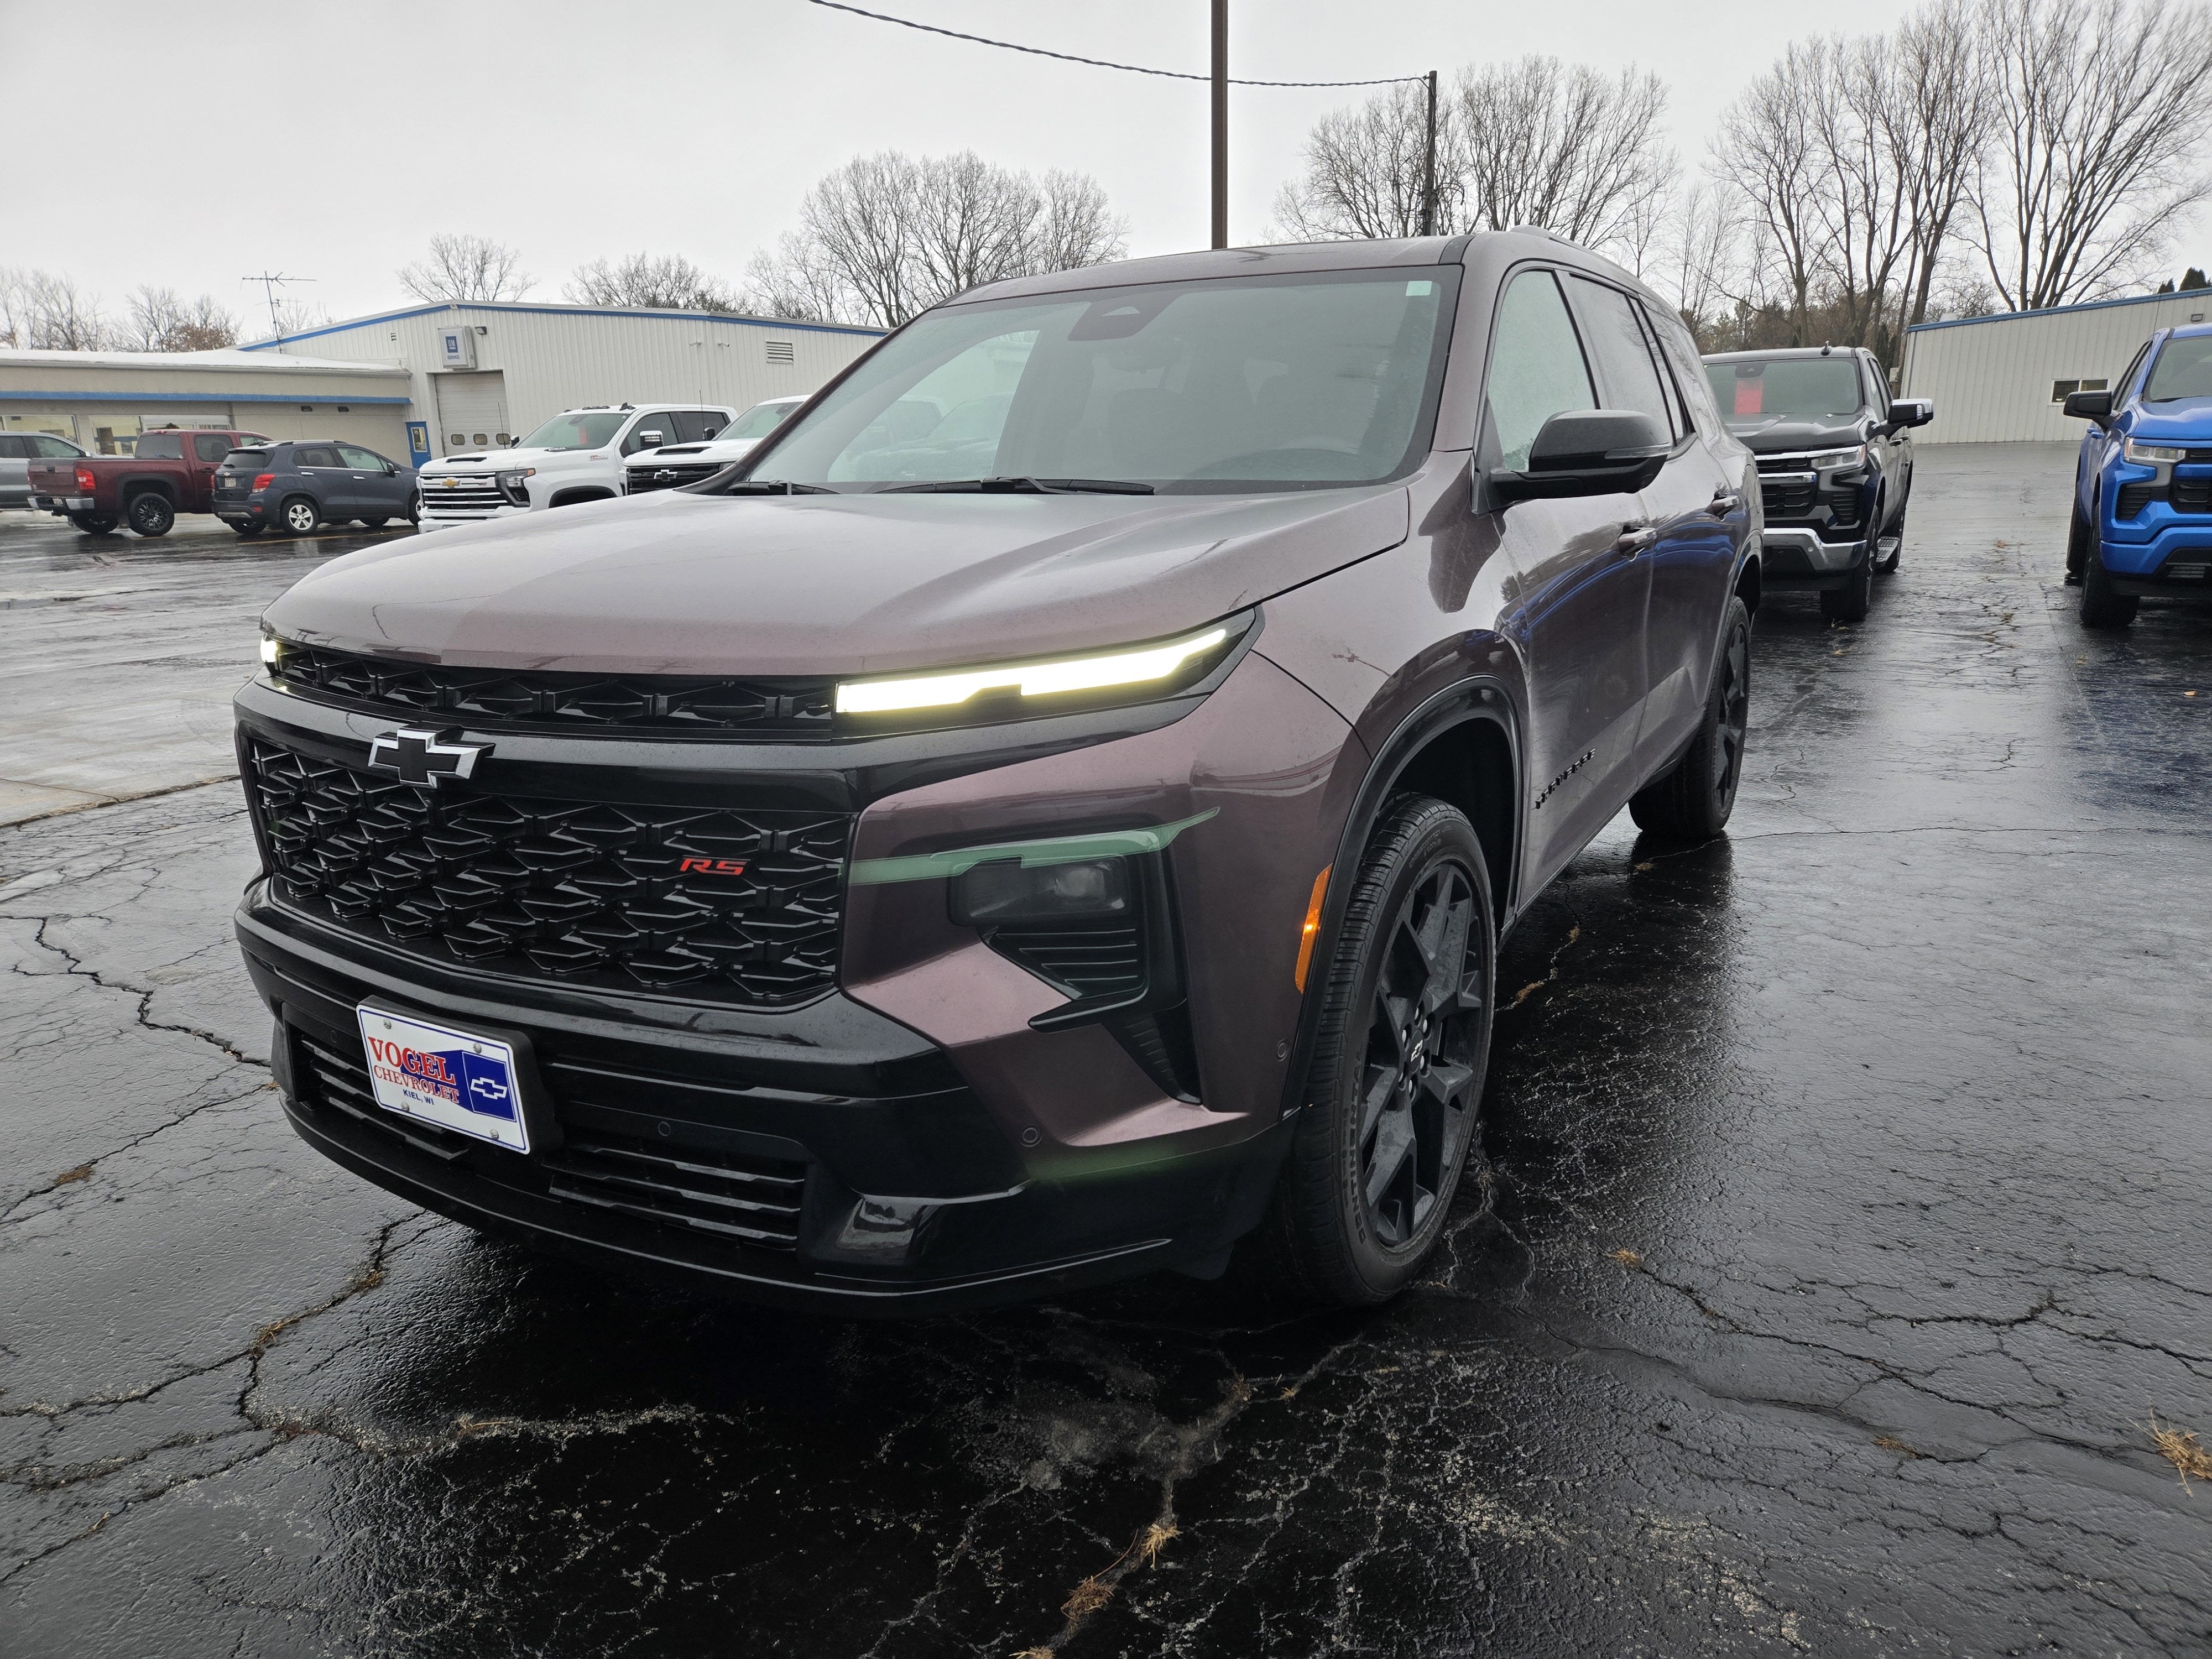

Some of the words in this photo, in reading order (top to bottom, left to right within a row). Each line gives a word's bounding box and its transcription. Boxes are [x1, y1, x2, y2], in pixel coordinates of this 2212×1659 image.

[448, 339, 456, 347] GM
[679, 858, 747, 875] RS
[368, 1036, 456, 1085] VOGEL
[374, 1065, 460, 1104] CHEVROLET
[403, 1089, 423, 1103] KIEL,
[424, 1095, 434, 1105] WI
